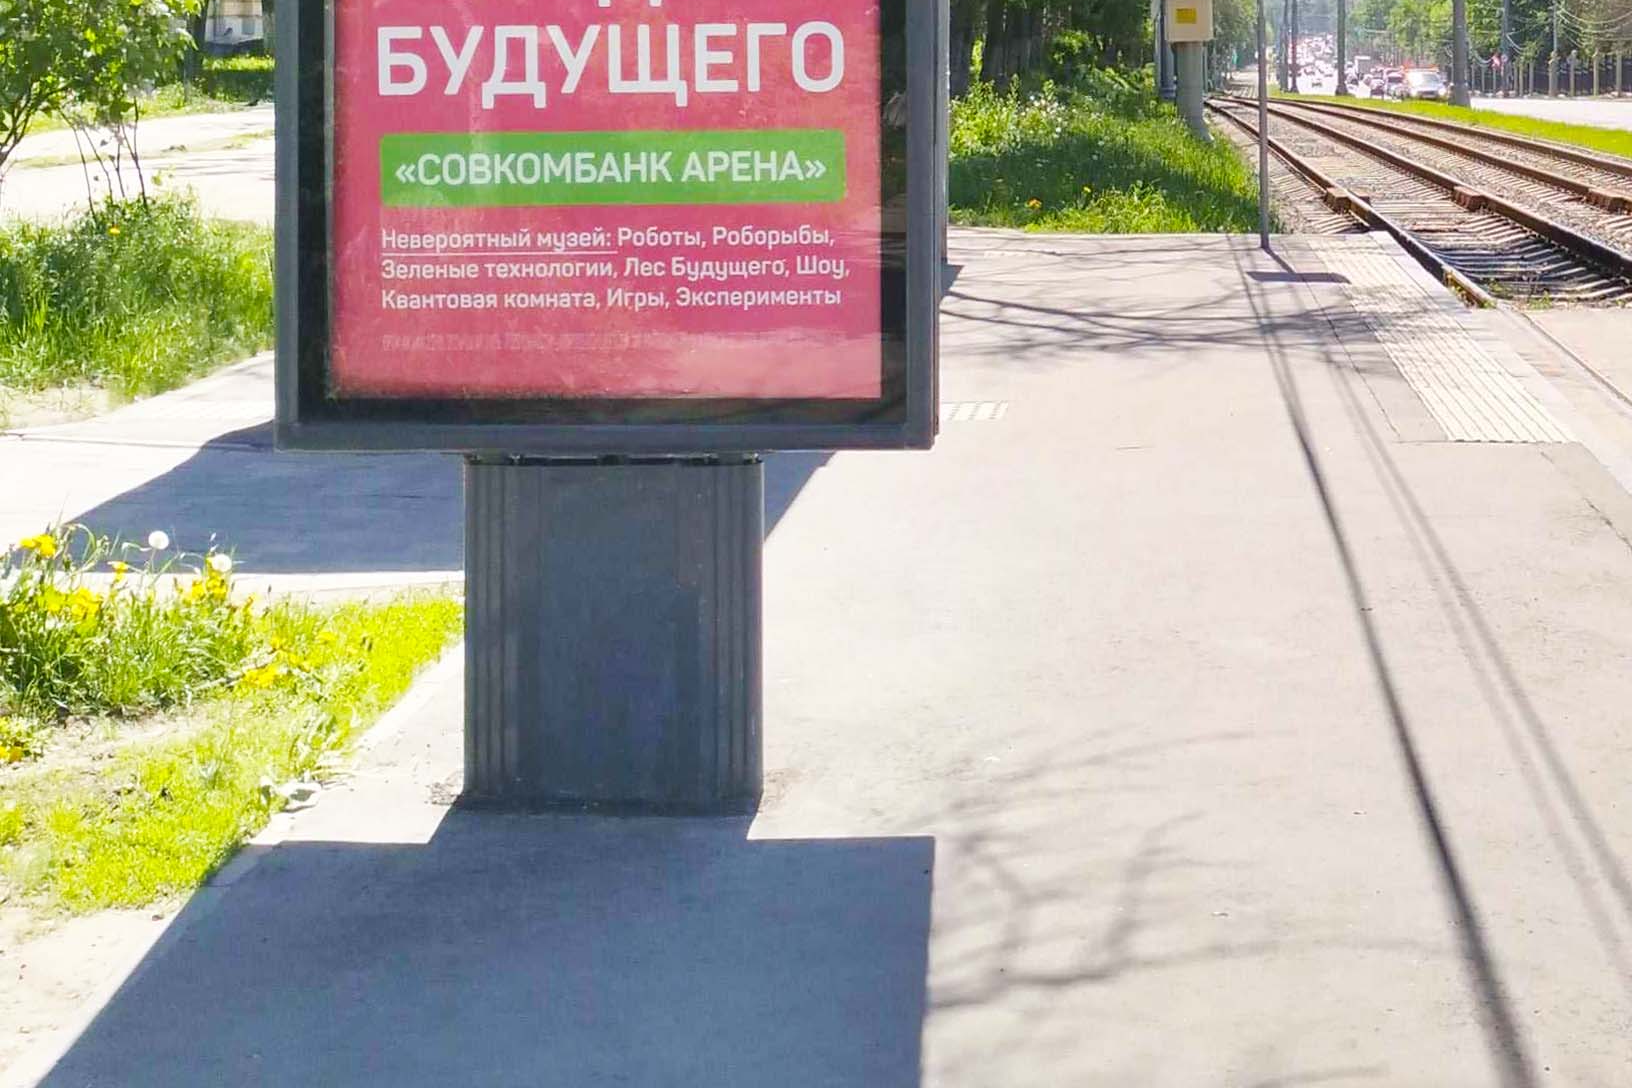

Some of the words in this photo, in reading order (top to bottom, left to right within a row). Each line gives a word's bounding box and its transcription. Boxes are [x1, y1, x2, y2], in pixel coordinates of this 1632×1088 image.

[377, 21, 845, 109] БУДУЩЕГО
[395, 151, 673, 185] «СОВКОМБАНК
[681, 150, 827, 183] АРЕНА»
[381, 228, 531, 252] Невероятный
[537, 226, 612, 252] музей:
[617, 226, 707, 248] Роботы,
[712, 225, 835, 250] Роборыбы,
[381, 260, 479, 279] Зеленые
[484, 262, 618, 279] технологии,
[623, 257, 666, 277] Лес
[671, 256, 790, 281] Будущего,
[796, 255, 851, 280] Шоу,
[381, 289, 498, 309] Квантовая
[504, 291, 602, 309] комната,
[607, 288, 670, 311] Игры,
[676, 287, 842, 311] Эксперименты
